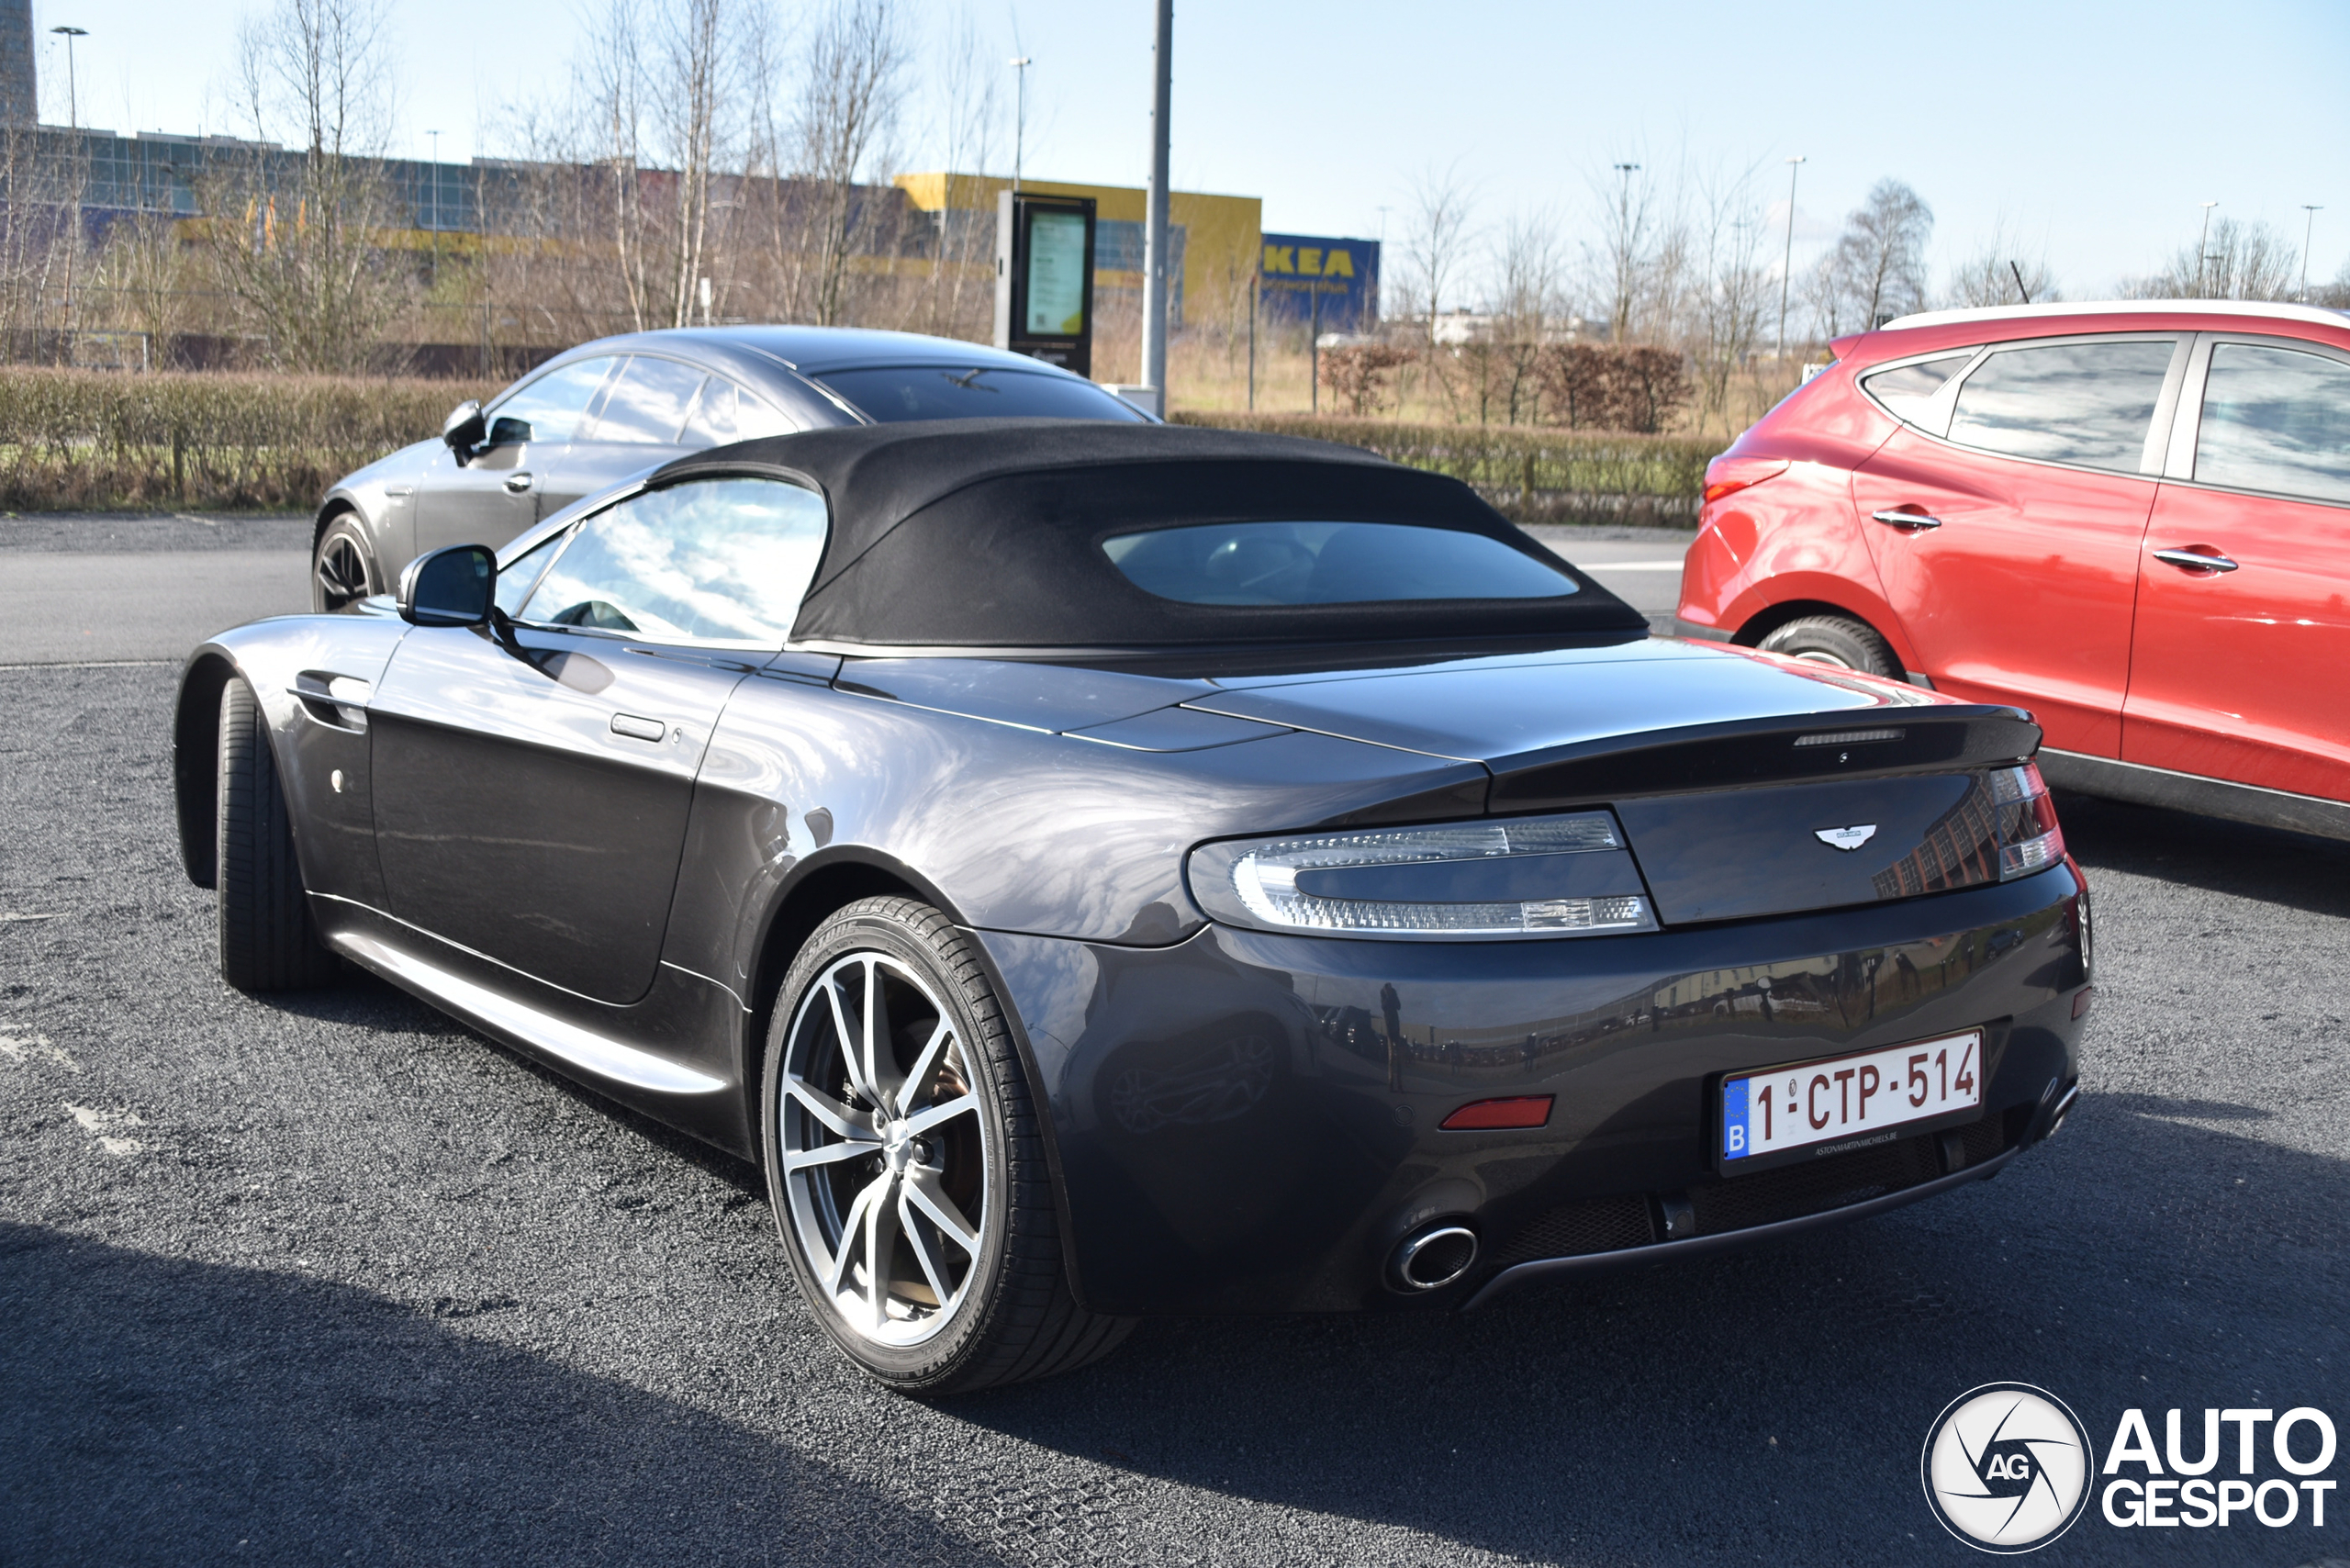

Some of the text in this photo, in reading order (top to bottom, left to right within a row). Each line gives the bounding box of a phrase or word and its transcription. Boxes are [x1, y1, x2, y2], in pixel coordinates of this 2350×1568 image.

[1263, 244, 1355, 278] KEA
[1757, 1043, 1975, 1141] 1-CTP-514
[1729, 1125, 1745, 1152] B
[1815, 1131, 1897, 1157] ASTONMARTINMICHIELS.BE
[912, 1297, 985, 1378] POTENZA
